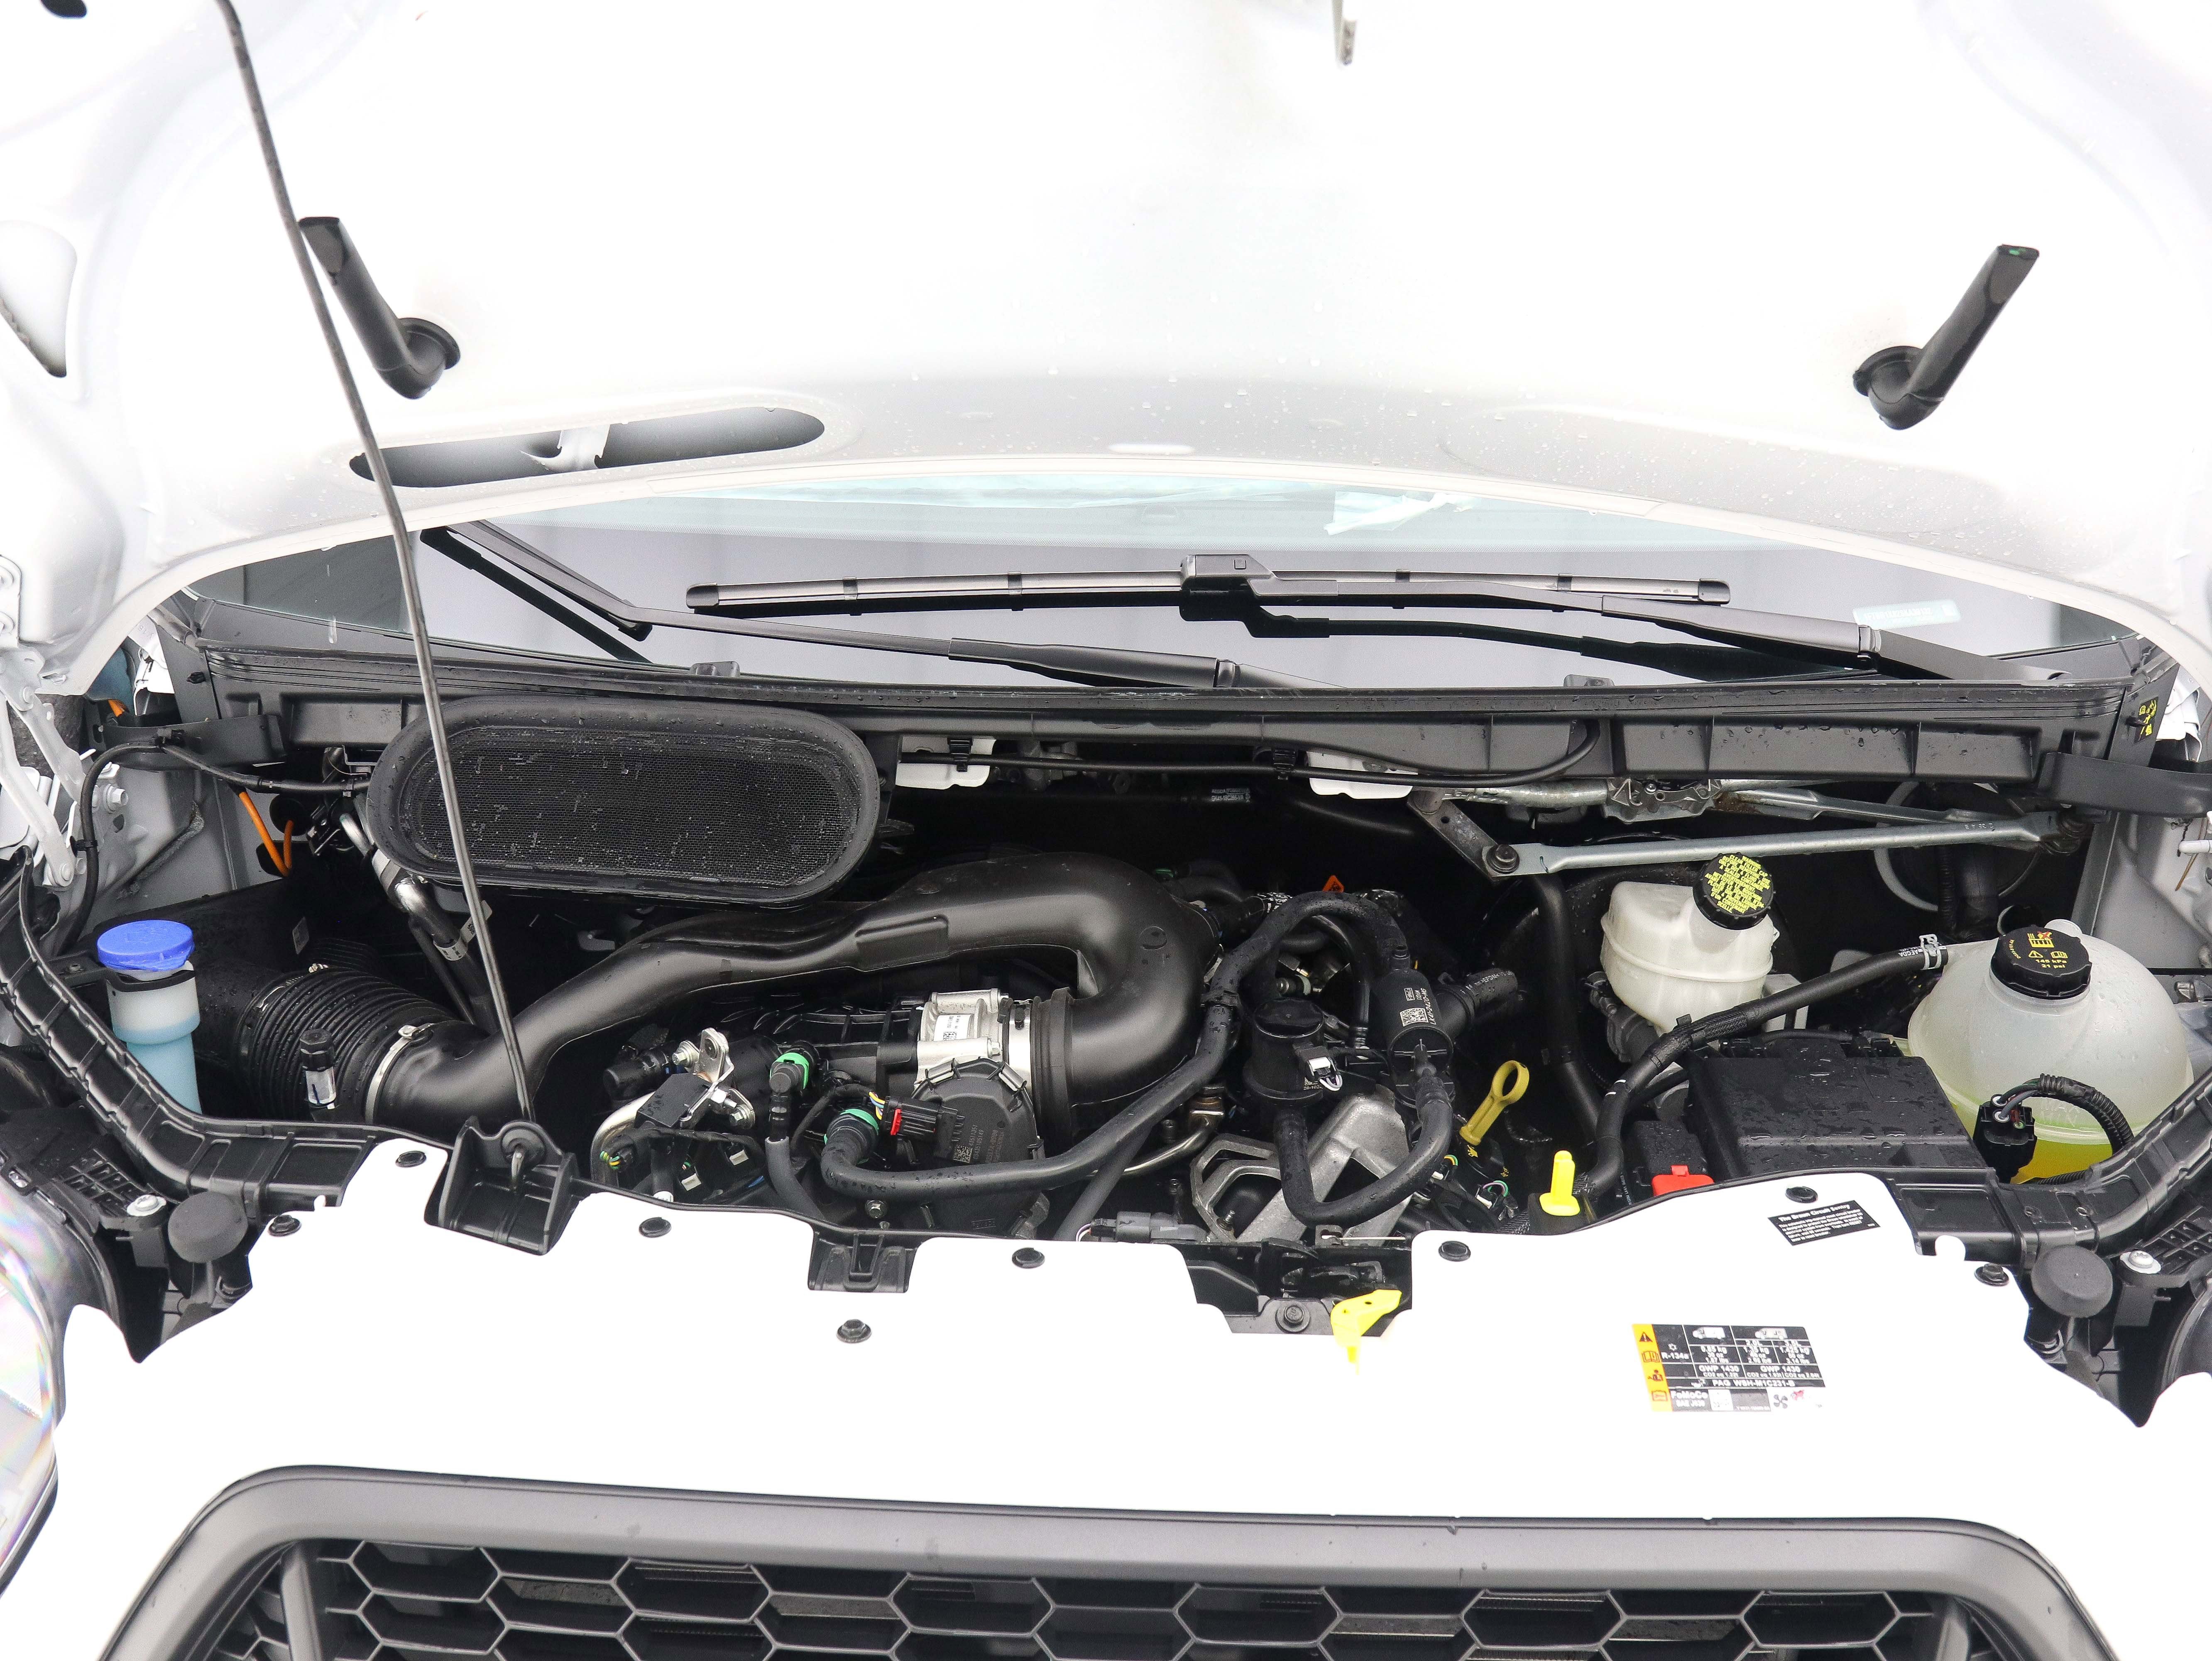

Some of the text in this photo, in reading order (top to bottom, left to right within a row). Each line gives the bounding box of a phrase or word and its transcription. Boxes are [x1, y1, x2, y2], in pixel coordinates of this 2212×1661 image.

[1722, 856, 1738, 867] BEFORE
[1730, 855, 1743, 865] CLEAN
[1744, 862, 1758, 872] FILLER
[1705, 873, 1719, 883] AVANT
[1719, 859, 1730, 868] ONLY
[1745, 873, 1757, 882] FLUID
[1757, 880, 1770, 889] FROM
[1724, 867, 1740, 878] SEALED
[1713, 872, 1734, 885] NETTOYER
[1742, 888, 1762, 901] BOUCHON
[1708, 880, 1724, 891] PLOYER
[1741, 898, 1758, 910] LIQUIDE
[1711, 892, 1746, 914] D'UN CONTENANT
[1725, 895, 1750, 910] PROVENANT
[1671, 1391, 1709, 1399] FoMoCo
